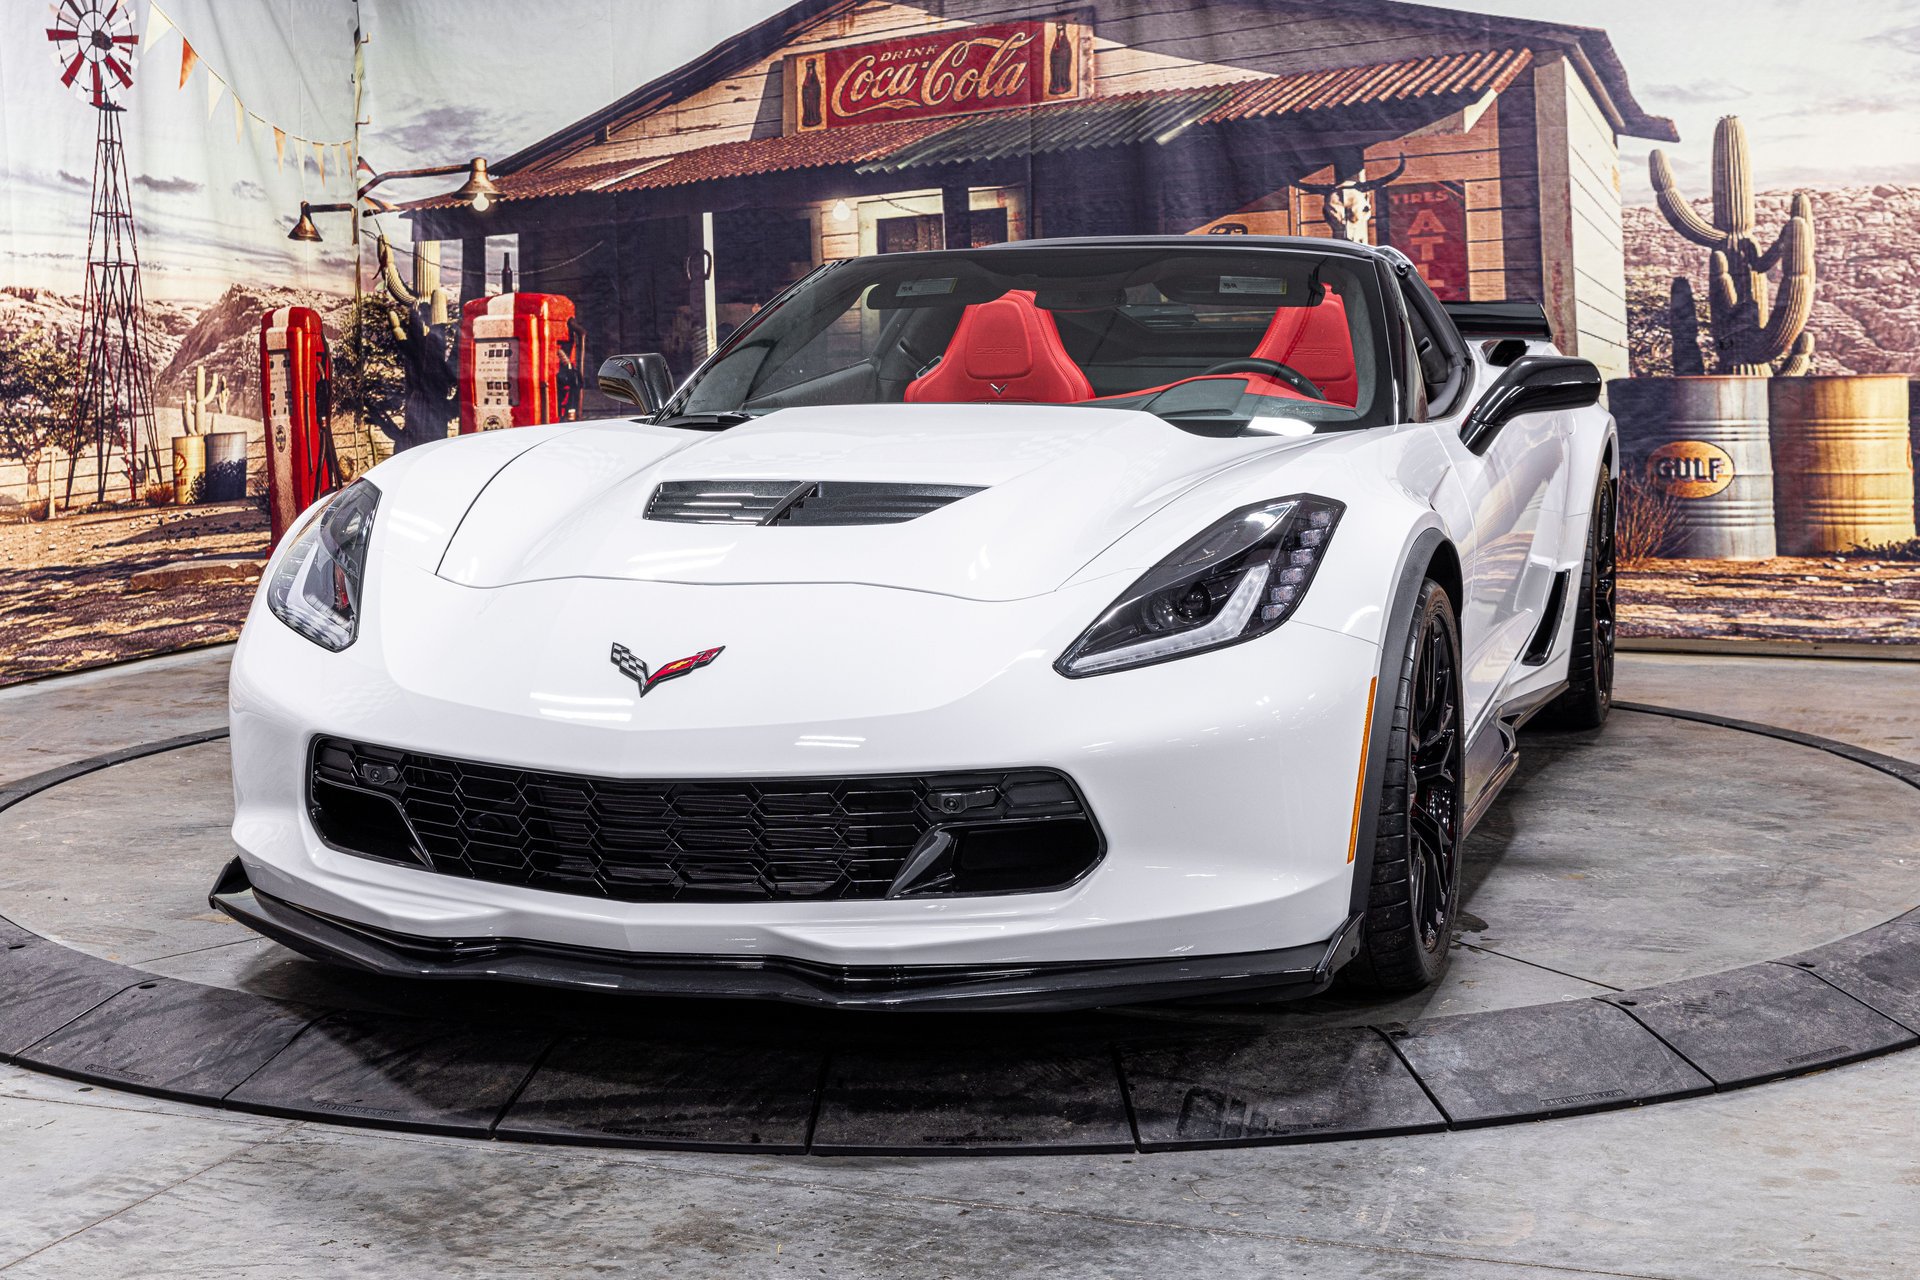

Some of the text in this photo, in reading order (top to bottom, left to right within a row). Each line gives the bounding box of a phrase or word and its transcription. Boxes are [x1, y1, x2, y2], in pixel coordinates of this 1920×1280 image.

[880, 44, 939, 62] DRINK
[831, 32, 1037, 117] Coca-Cola
[1391, 190, 1449, 205] TIRES
[1656, 457, 1725, 482] GULF
